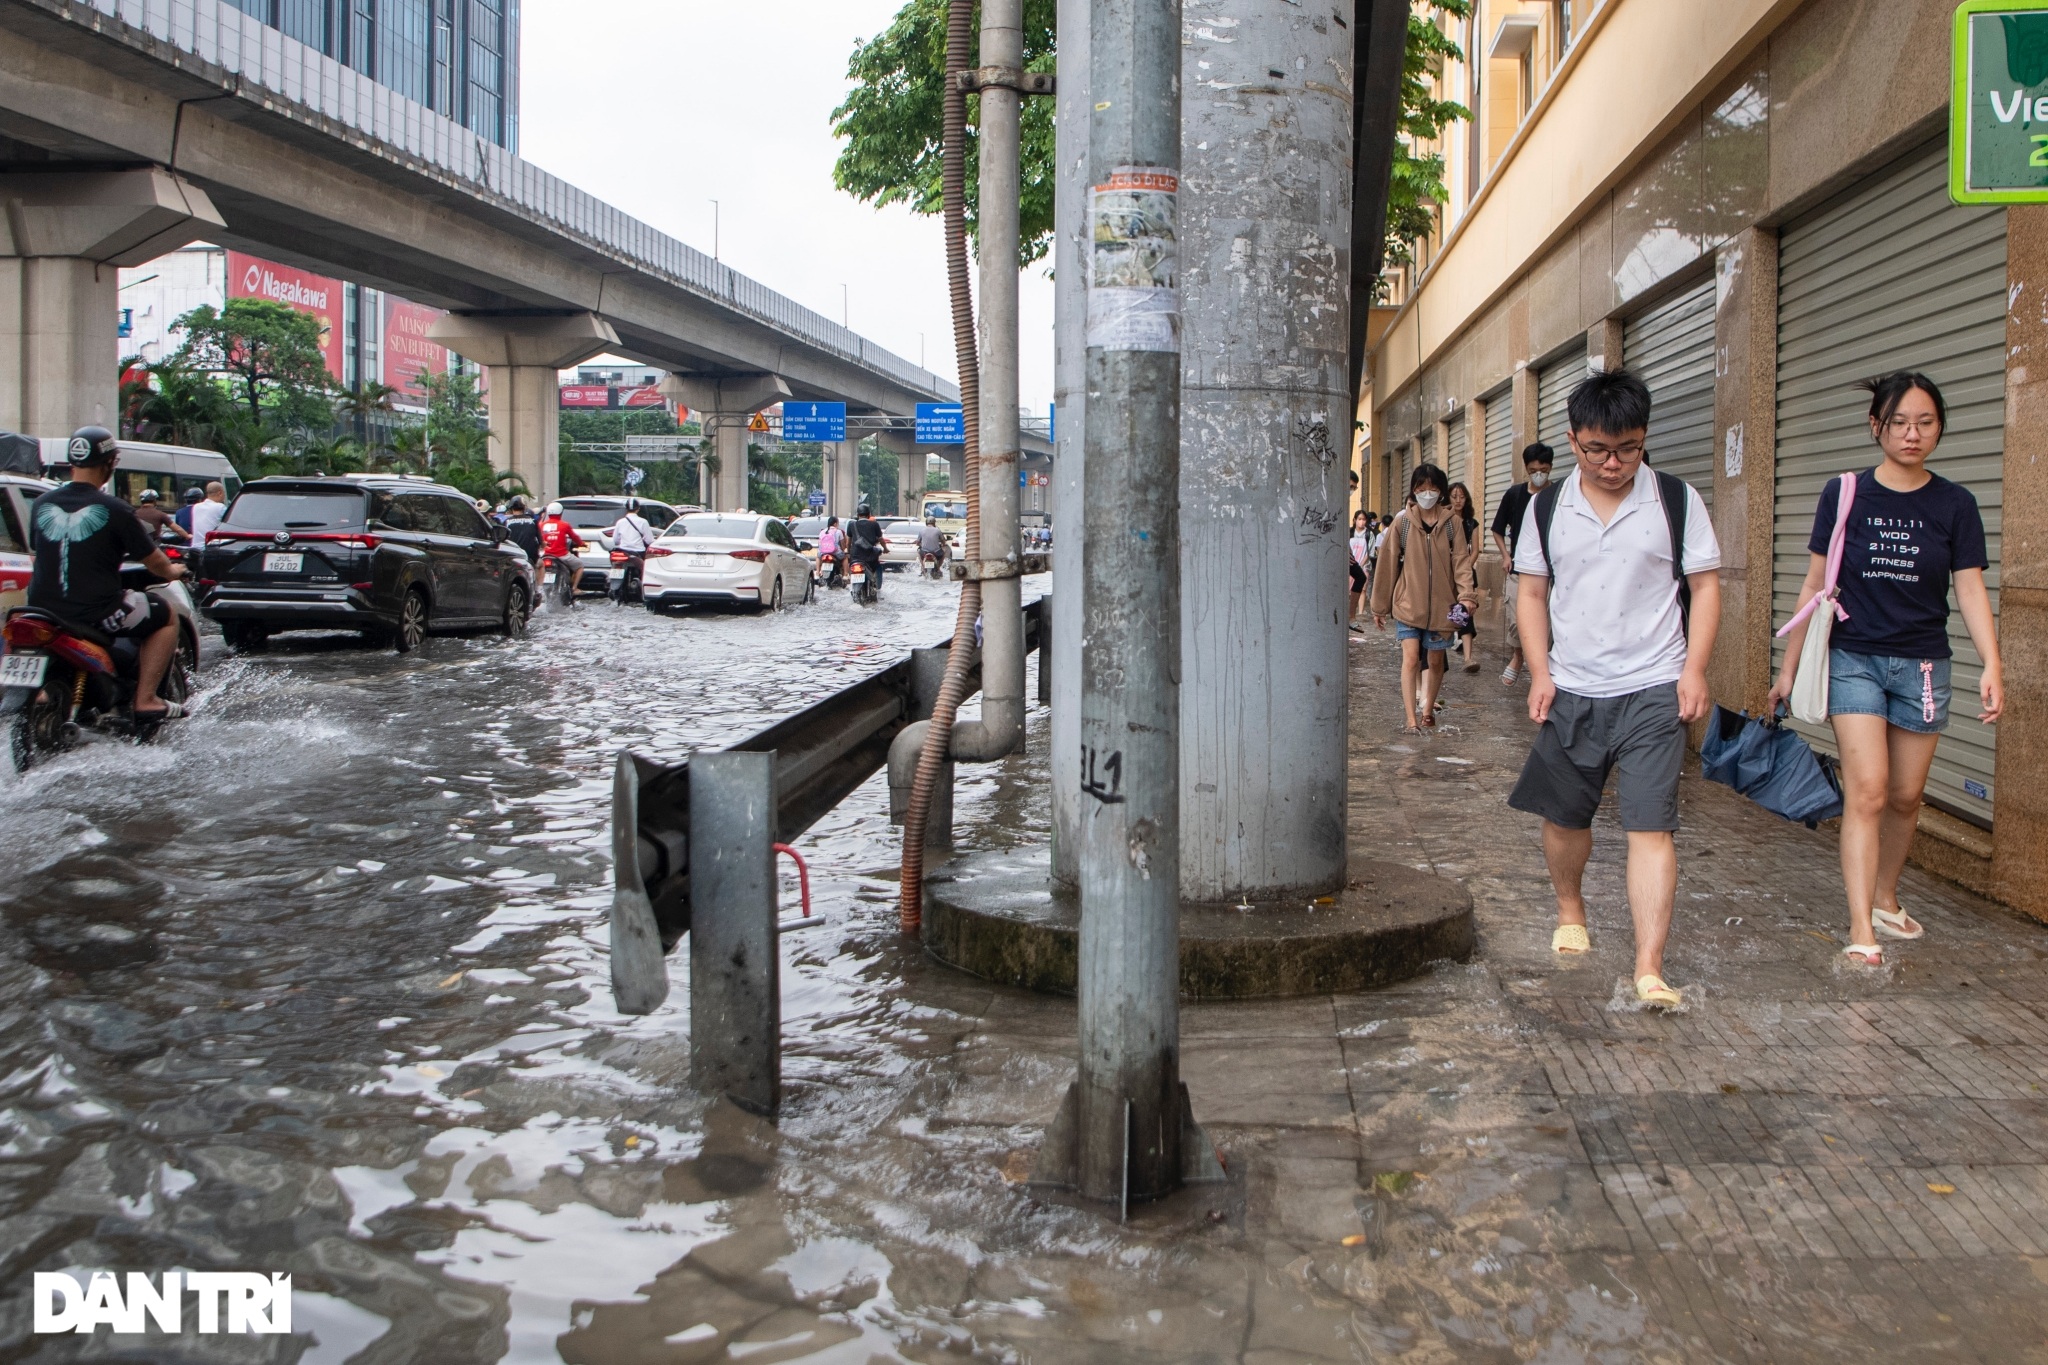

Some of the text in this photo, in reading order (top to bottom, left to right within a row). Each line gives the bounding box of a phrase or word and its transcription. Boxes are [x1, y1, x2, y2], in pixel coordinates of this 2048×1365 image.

[263, 270, 327, 309] Nagakawa
[408, 338, 440, 360] BUFFET
[1867, 517, 1923, 528] 18.11.11
[1880, 531, 1910, 540] WOD
[270, 562, 298, 571] 182.02
[1871, 557, 1915, 568] FITNESS
[1862, 571, 1919, 582] HAPPINESS
